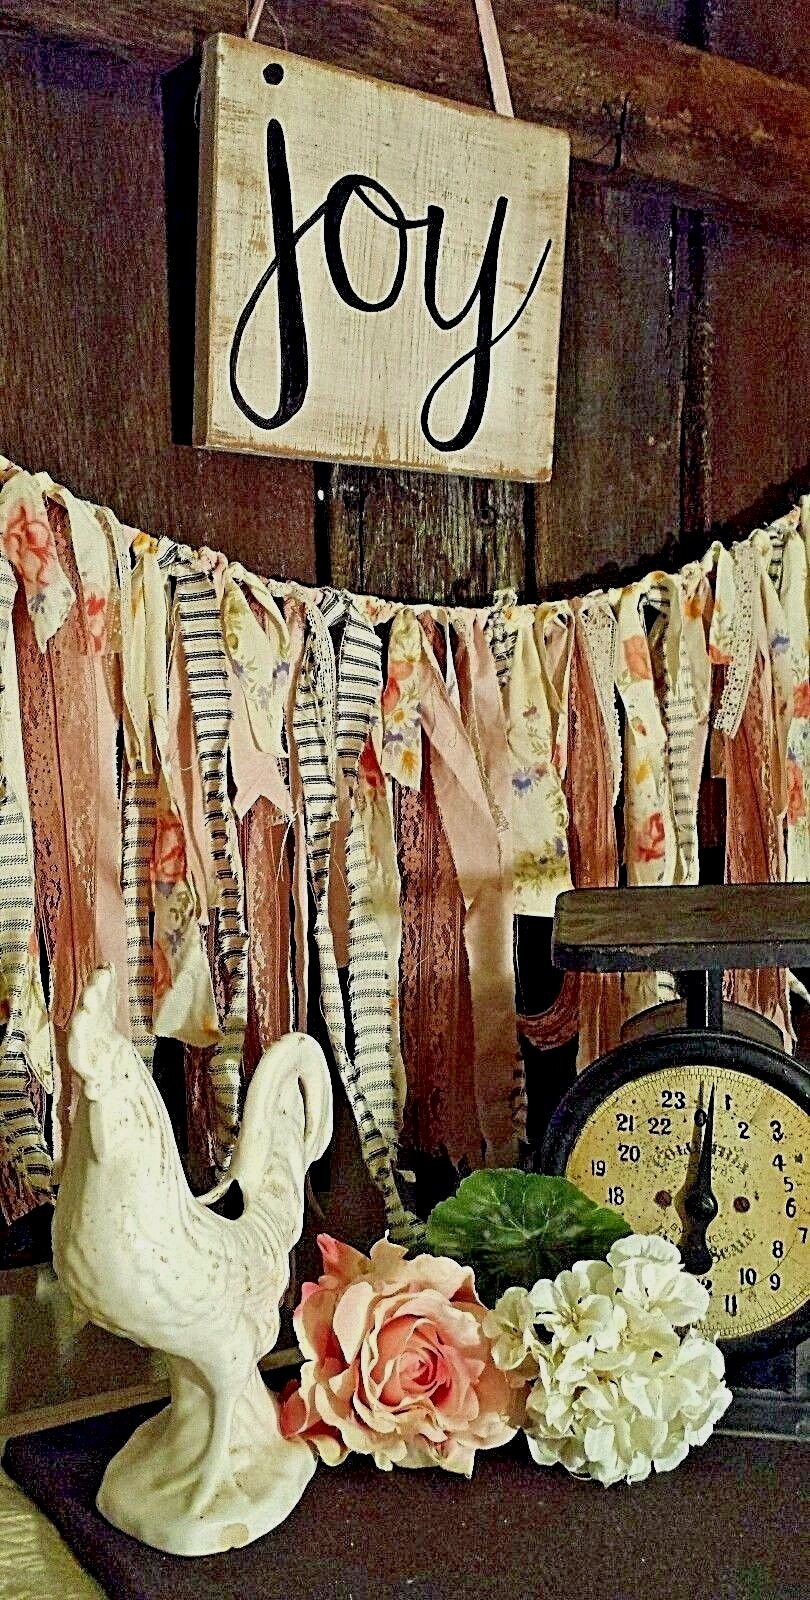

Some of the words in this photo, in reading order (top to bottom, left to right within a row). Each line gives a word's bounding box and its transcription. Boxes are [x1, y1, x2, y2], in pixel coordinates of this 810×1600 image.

[229, 63, 552, 452] joy
[661, 1090, 686, 1110] 23
[725, 1094, 732, 1111] 1
[616, 1113, 634, 1132] 21
[648, 1117, 672, 1136] 22
[738, 1121, 750, 1139] 2
[770, 1120, 784, 1142] 3
[618, 1143, 640, 1162] 20
[592, 1160, 606, 1177] 19
[772, 1153, 786, 1172] 4
[783, 1176, 794, 1193] 5
[608, 1187, 625, 1206] 18
[785, 1197, 796, 1218] 6
[797, 1227, 808, 1244] 7
[773, 1240, 783, 1258] 8
[740, 1267, 757, 1286] 10
[769, 1273, 781, 1291] 9
[725, 1294, 737, 1316] 11
